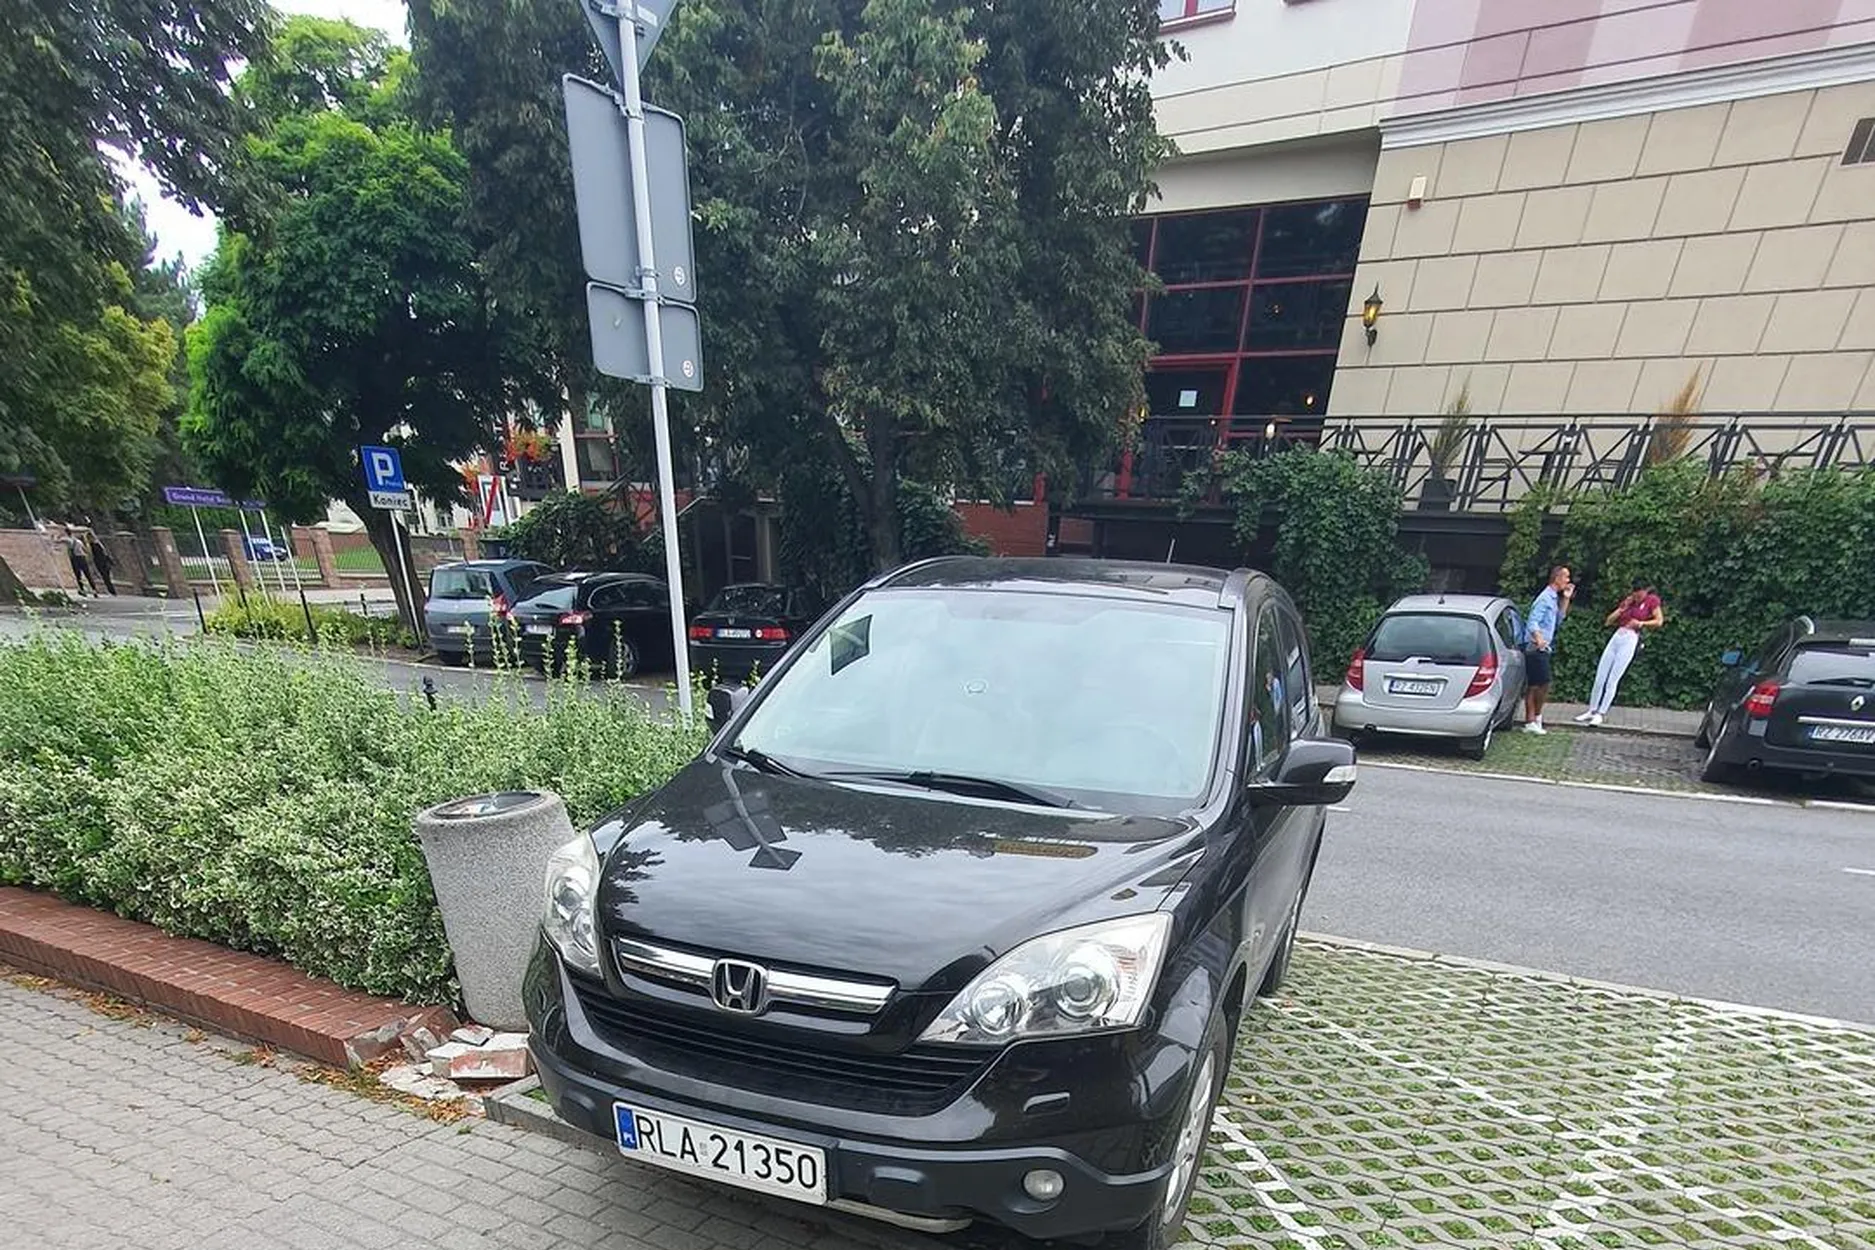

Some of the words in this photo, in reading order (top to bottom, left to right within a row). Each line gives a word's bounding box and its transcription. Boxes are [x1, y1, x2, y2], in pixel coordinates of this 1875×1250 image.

[371, 452, 395, 486] P
[372, 494, 409, 507] Koniec
[635, 1114, 699, 1164] RLA
[709, 1133, 818, 1189] 21350
